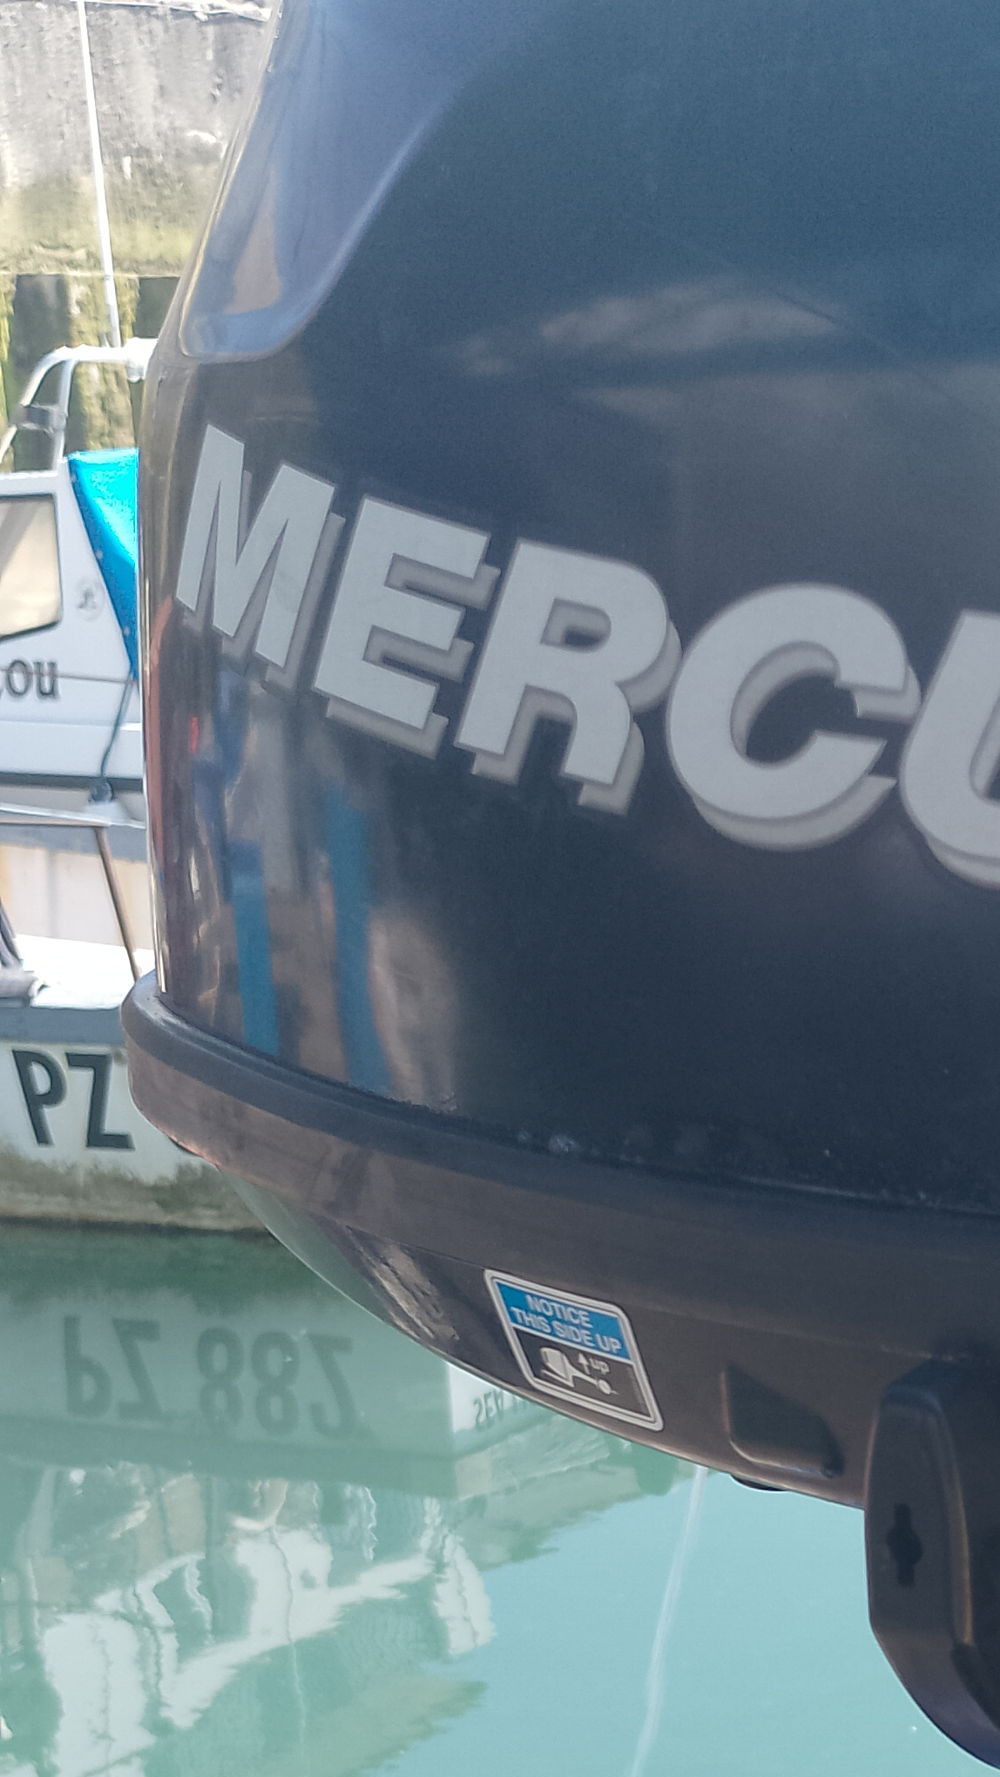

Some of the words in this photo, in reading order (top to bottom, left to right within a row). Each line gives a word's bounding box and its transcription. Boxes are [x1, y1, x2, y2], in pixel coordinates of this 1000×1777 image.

[0, 658, 60, 700] ou
[13, 1048, 135, 1150] PZ
[511, 1307, 550, 1333] THIS
[552, 1321, 594, 1346] SIDE
[596, 1334, 622, 1354] UP
[526, 1295, 593, 1328] NOTICE
